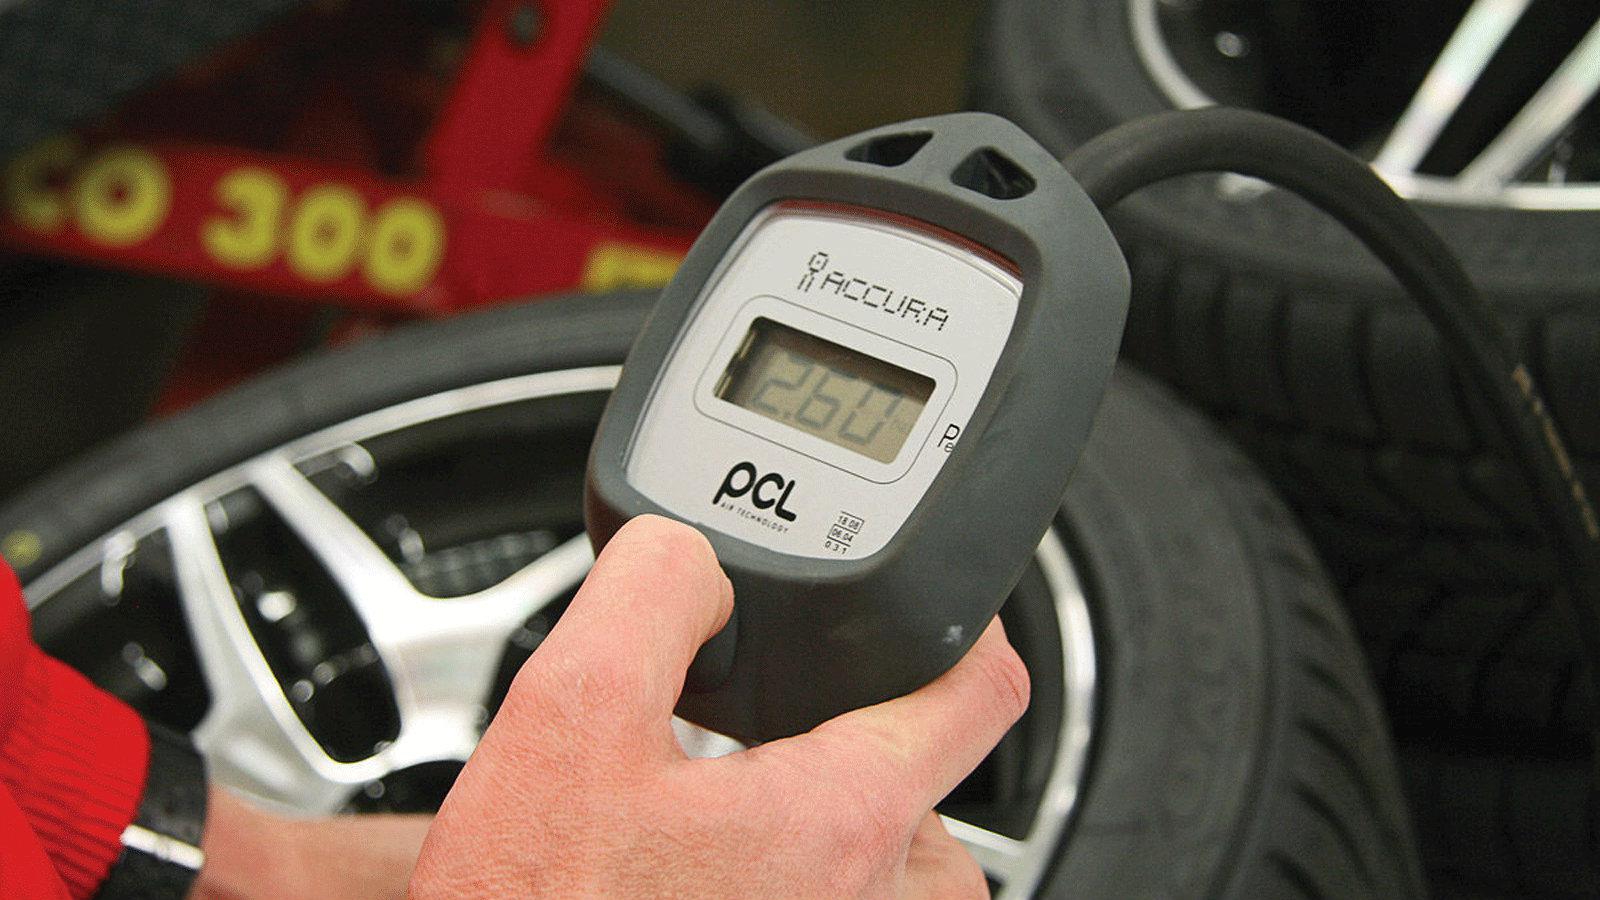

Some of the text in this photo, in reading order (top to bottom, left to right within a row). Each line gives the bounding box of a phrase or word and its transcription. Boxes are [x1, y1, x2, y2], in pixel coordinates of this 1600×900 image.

[202, 166, 446, 297] 300
[819, 270, 950, 332] ACCURA
[751, 351, 906, 447] 2.60
